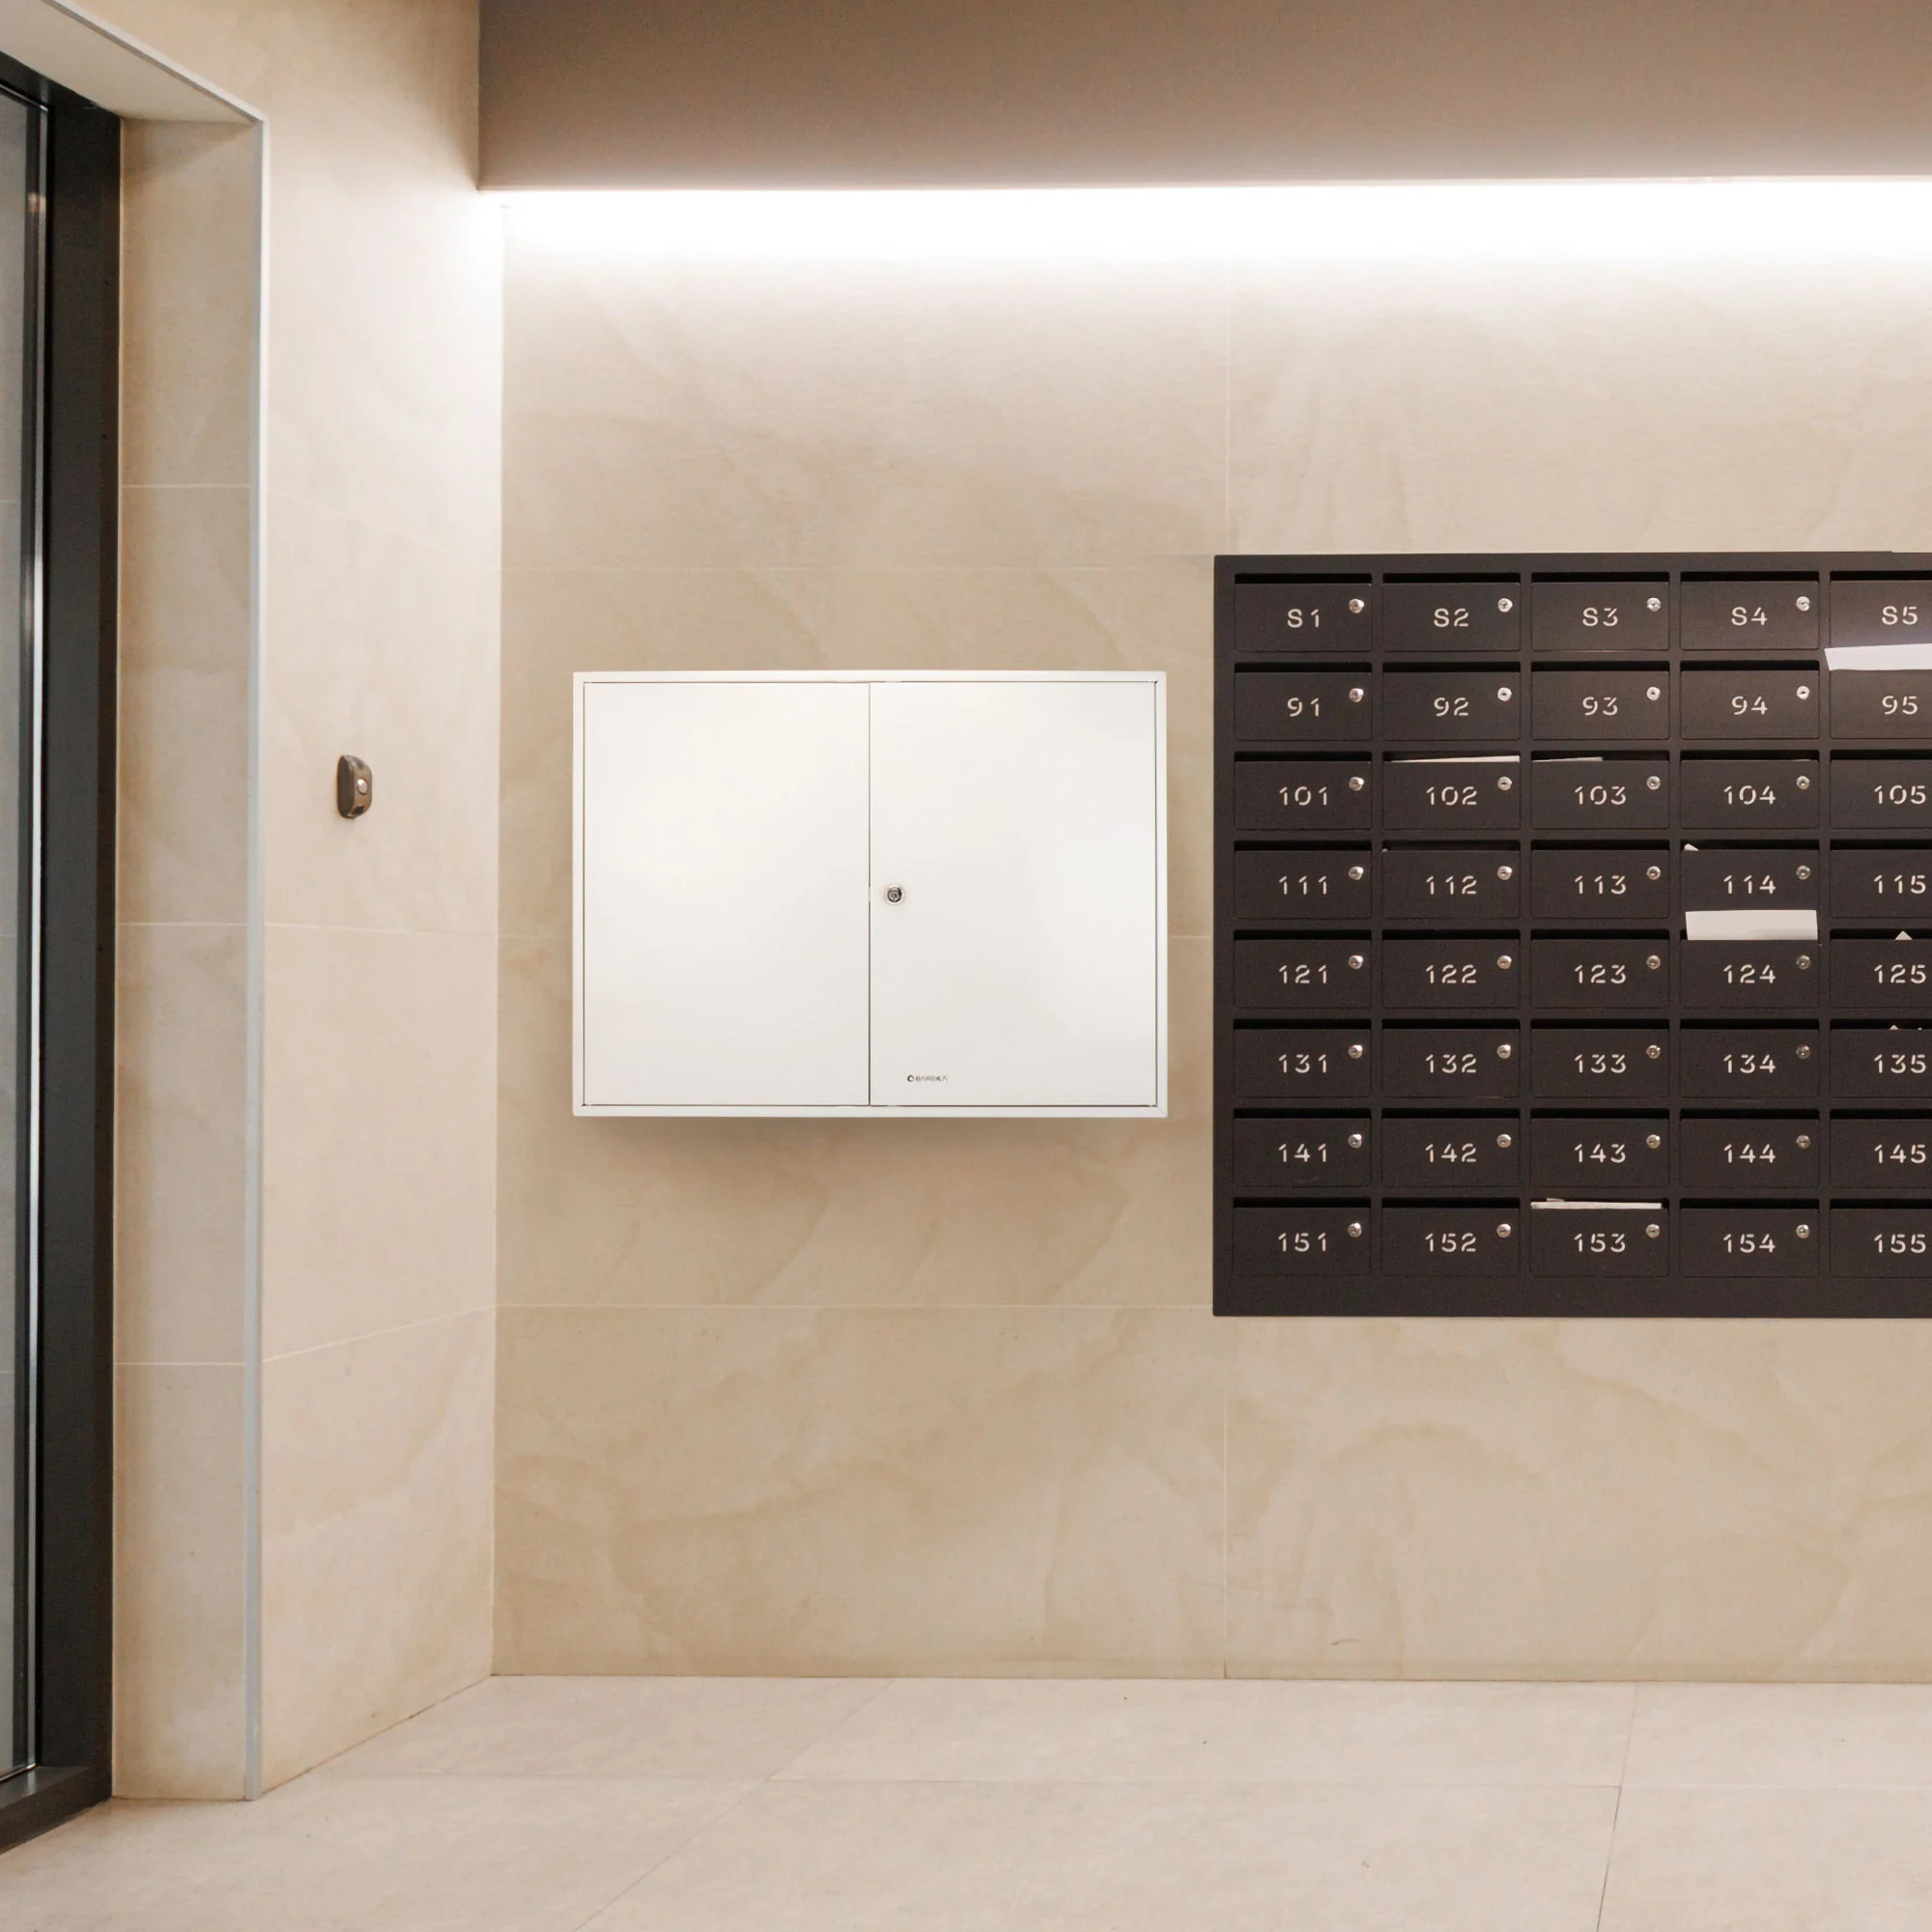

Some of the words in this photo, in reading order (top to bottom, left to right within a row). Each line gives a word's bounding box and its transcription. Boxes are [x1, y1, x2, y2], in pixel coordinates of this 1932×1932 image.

[1287, 608, 1320, 629] S1
[1433, 608, 1469, 628] S2
[1581, 607, 1619, 627] S3
[1730, 606, 1768, 627] S4
[1881, 605, 1918, 626] S5
[1287, 696, 1320, 718] 91
[1433, 696, 1469, 717] 92
[1581, 696, 1618, 717] 93
[1731, 696, 1769, 716] 94
[1881, 695, 1918, 716] 95
[1279, 785, 1327, 807] 101
[1426, 785, 1478, 807] 102
[1574, 785, 1627, 806] 103
[1723, 784, 1776, 806] 104
[1873, 784, 1926, 805] 105
[1278, 875, 1327, 895] 111
[1425, 874, 1477, 895] 112
[1574, 874, 1627, 895] 113
[1723, 874, 1776, 895] 114
[1873, 874, 1926, 895] 115
[1278, 964, 1327, 984] 121
[1425, 963, 1477, 984] 122
[1574, 963, 1627, 984] 123
[1722, 963, 1776, 984] 124
[1873, 963, 1927, 984] 125
[1278, 1053, 1327, 1074] 131
[1425, 1053, 1477, 1074] 132
[1574, 1053, 1627, 1074] 133
[1722, 1054, 1776, 1074] 134
[1873, 1053, 1927, 1074] 135
[1278, 1143, 1327, 1163] 141
[1425, 1143, 1477, 1163] 142
[1574, 1143, 1627, 1164] 143
[1723, 1143, 1776, 1164] 144
[1873, 1143, 1927, 1164] 145
[1277, 1232, 1326, 1253] 151
[1425, 1232, 1477, 1253] 152
[1574, 1233, 1626, 1253] 153
[1722, 1233, 1776, 1254] 154
[1873, 1233, 1927, 1254] 155
